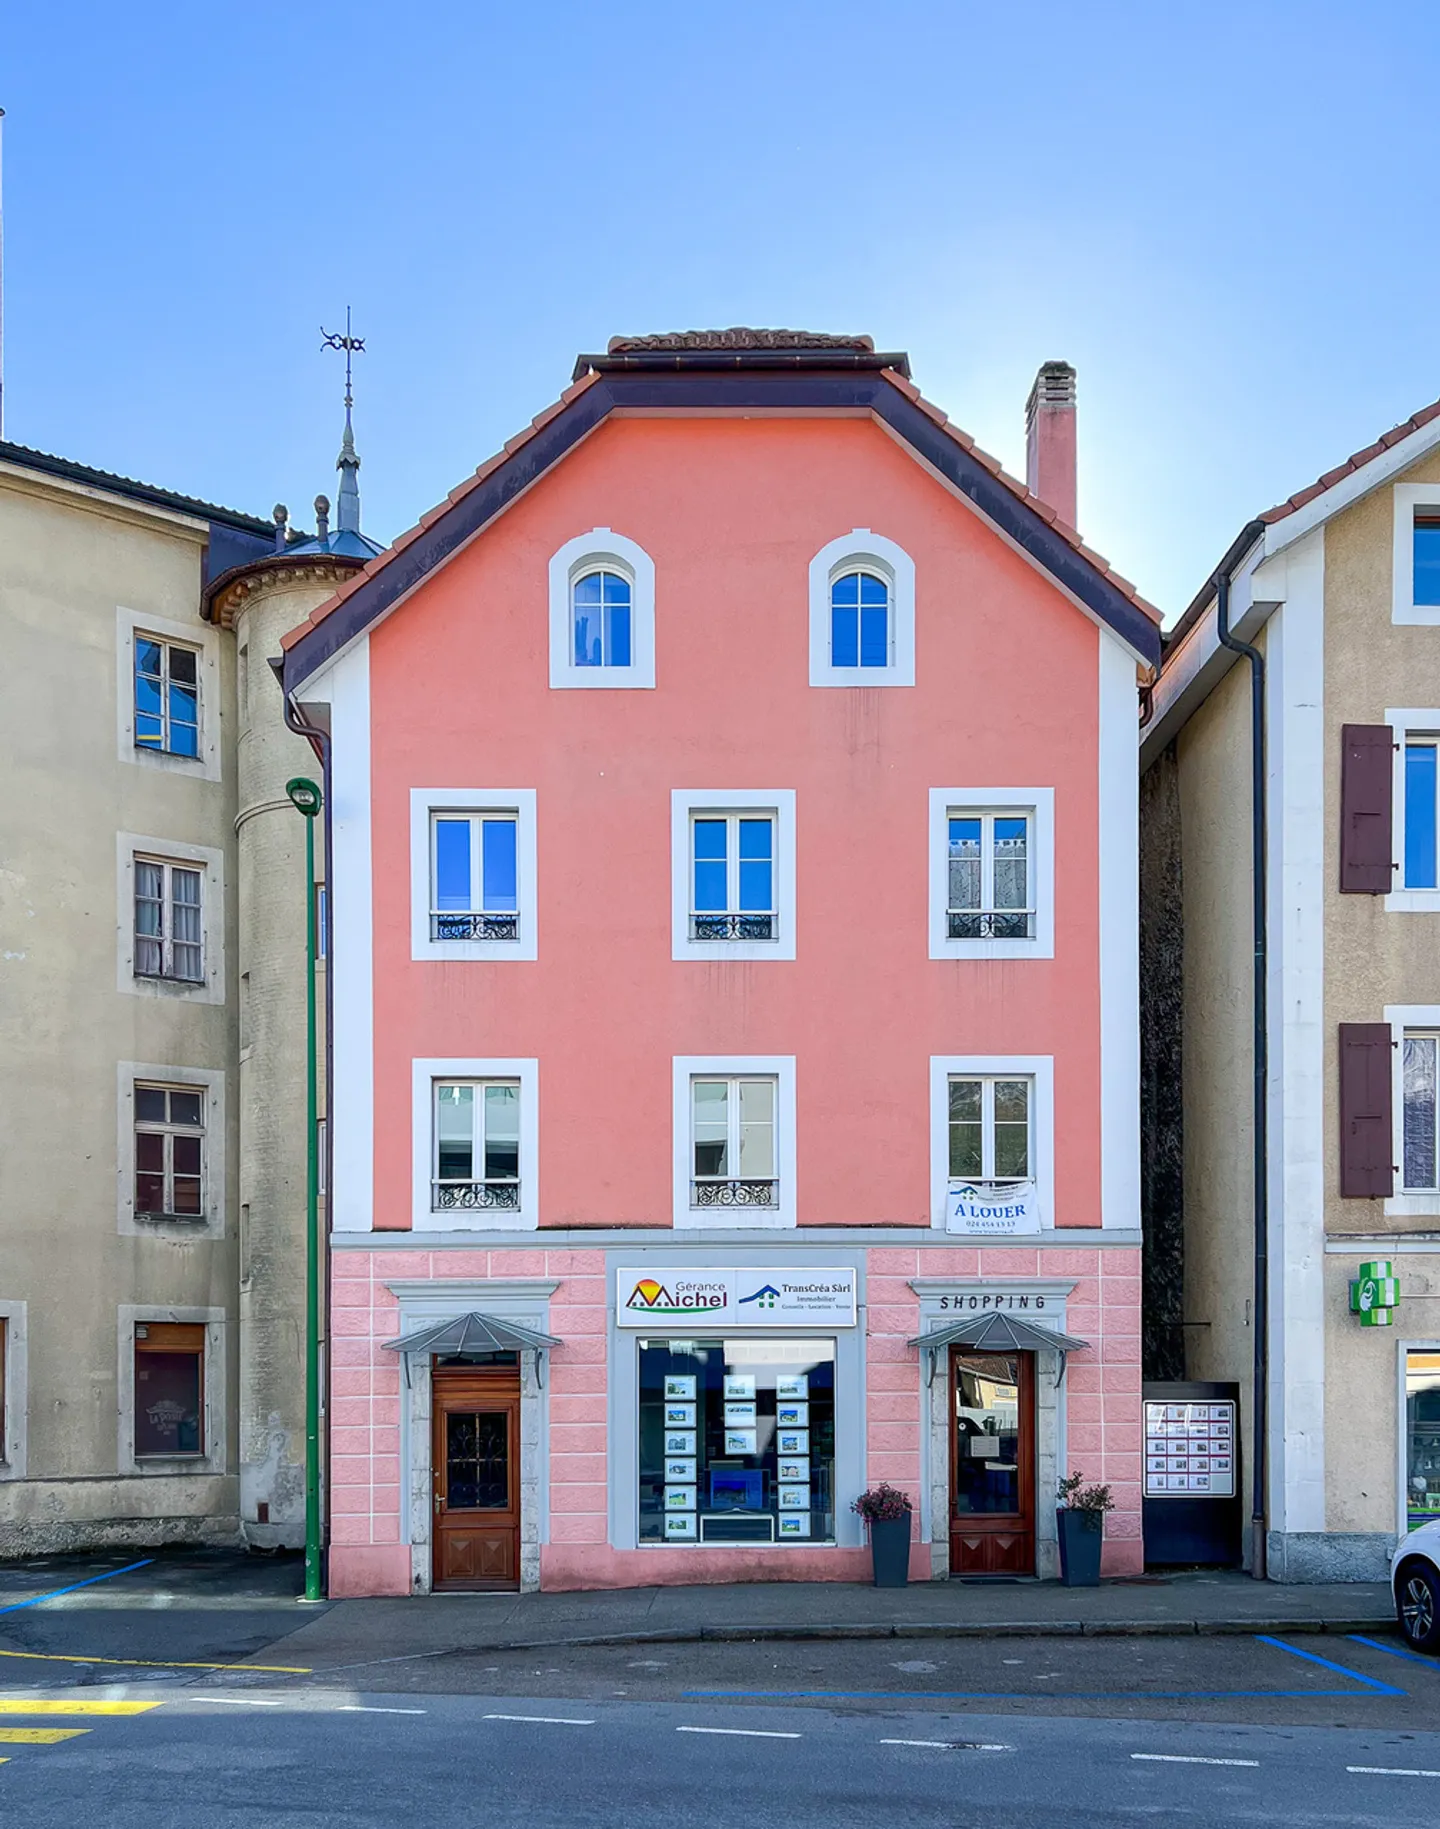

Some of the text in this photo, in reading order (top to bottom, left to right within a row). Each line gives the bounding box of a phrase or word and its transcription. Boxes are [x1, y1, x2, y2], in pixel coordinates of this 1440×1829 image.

[954, 1203, 1026, 1218] A LOUER
[675, 1281, 726, 1292] Gérance
[781, 1284, 830, 1293] TransCréa
[940, 1295, 1045, 1309] SHOPPING
